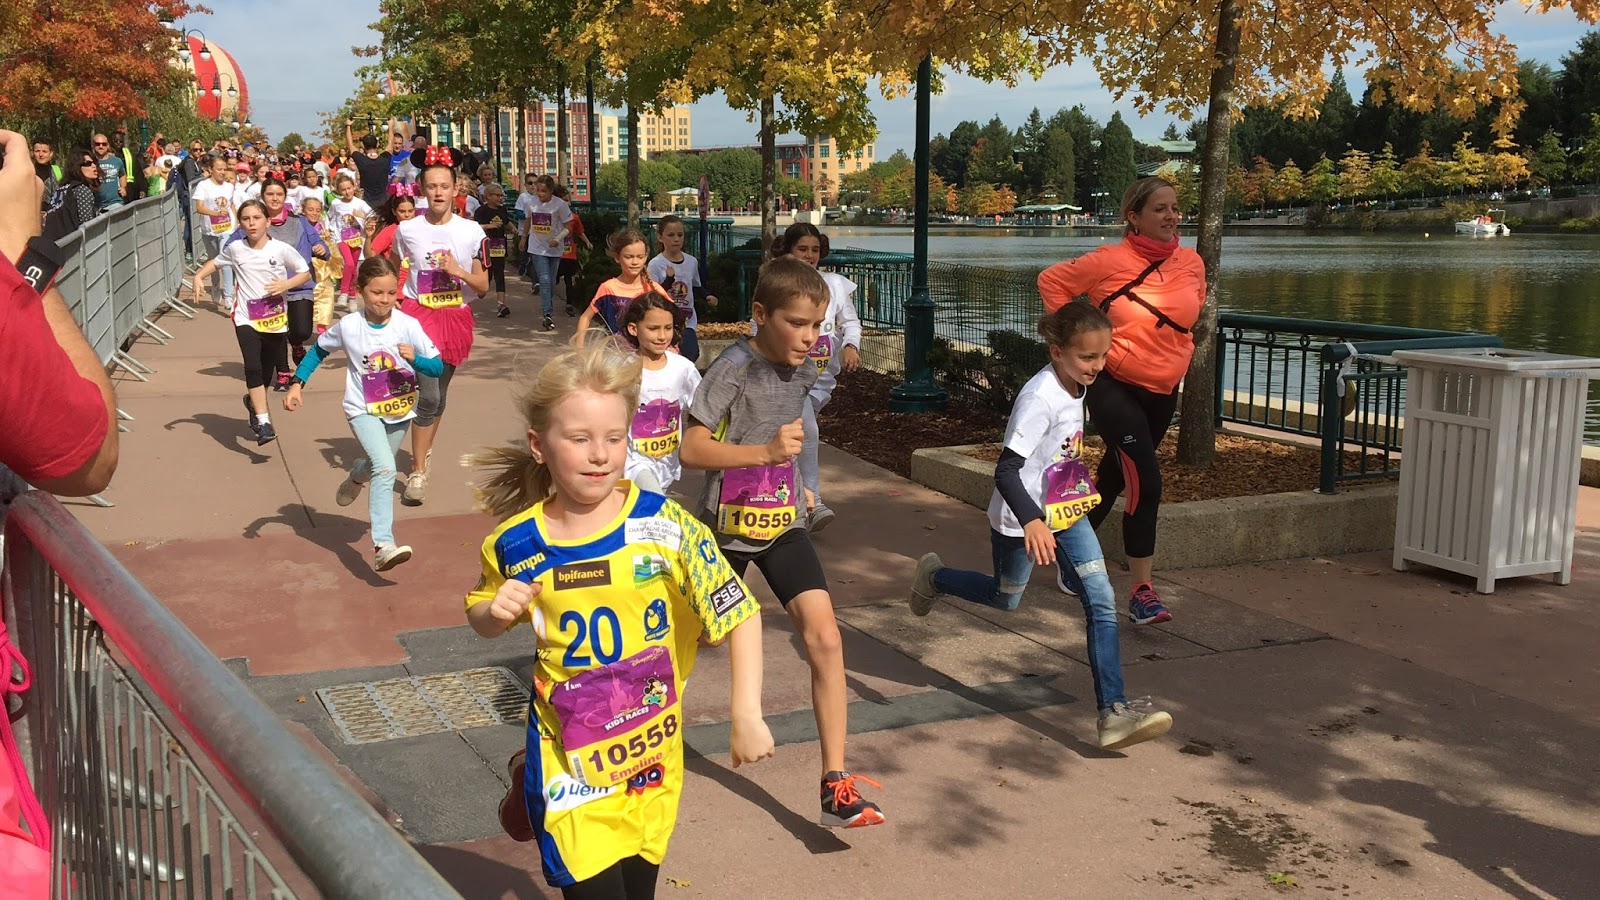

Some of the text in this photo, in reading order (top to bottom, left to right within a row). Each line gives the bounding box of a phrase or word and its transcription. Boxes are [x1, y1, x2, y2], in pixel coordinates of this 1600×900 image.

[426, 293, 459, 304] 10391
[257, 315, 285, 328] 10557
[376, 396, 414, 414] 10656
[642, 434, 678, 452] 10974
[732, 510, 792, 528] 10559
[749, 530, 769, 538] Paul
[505, 552, 546, 578] Kempa
[558, 569, 605, 583] bpifrance
[713, 583, 740, 608] FSE
[559, 606, 623, 667] 20
[563, 680, 582, 691] 1 km
[604, 706, 650, 731] KIDS RACES
[588, 714, 678, 773] 10558
[609, 752, 663, 782] Emeline
